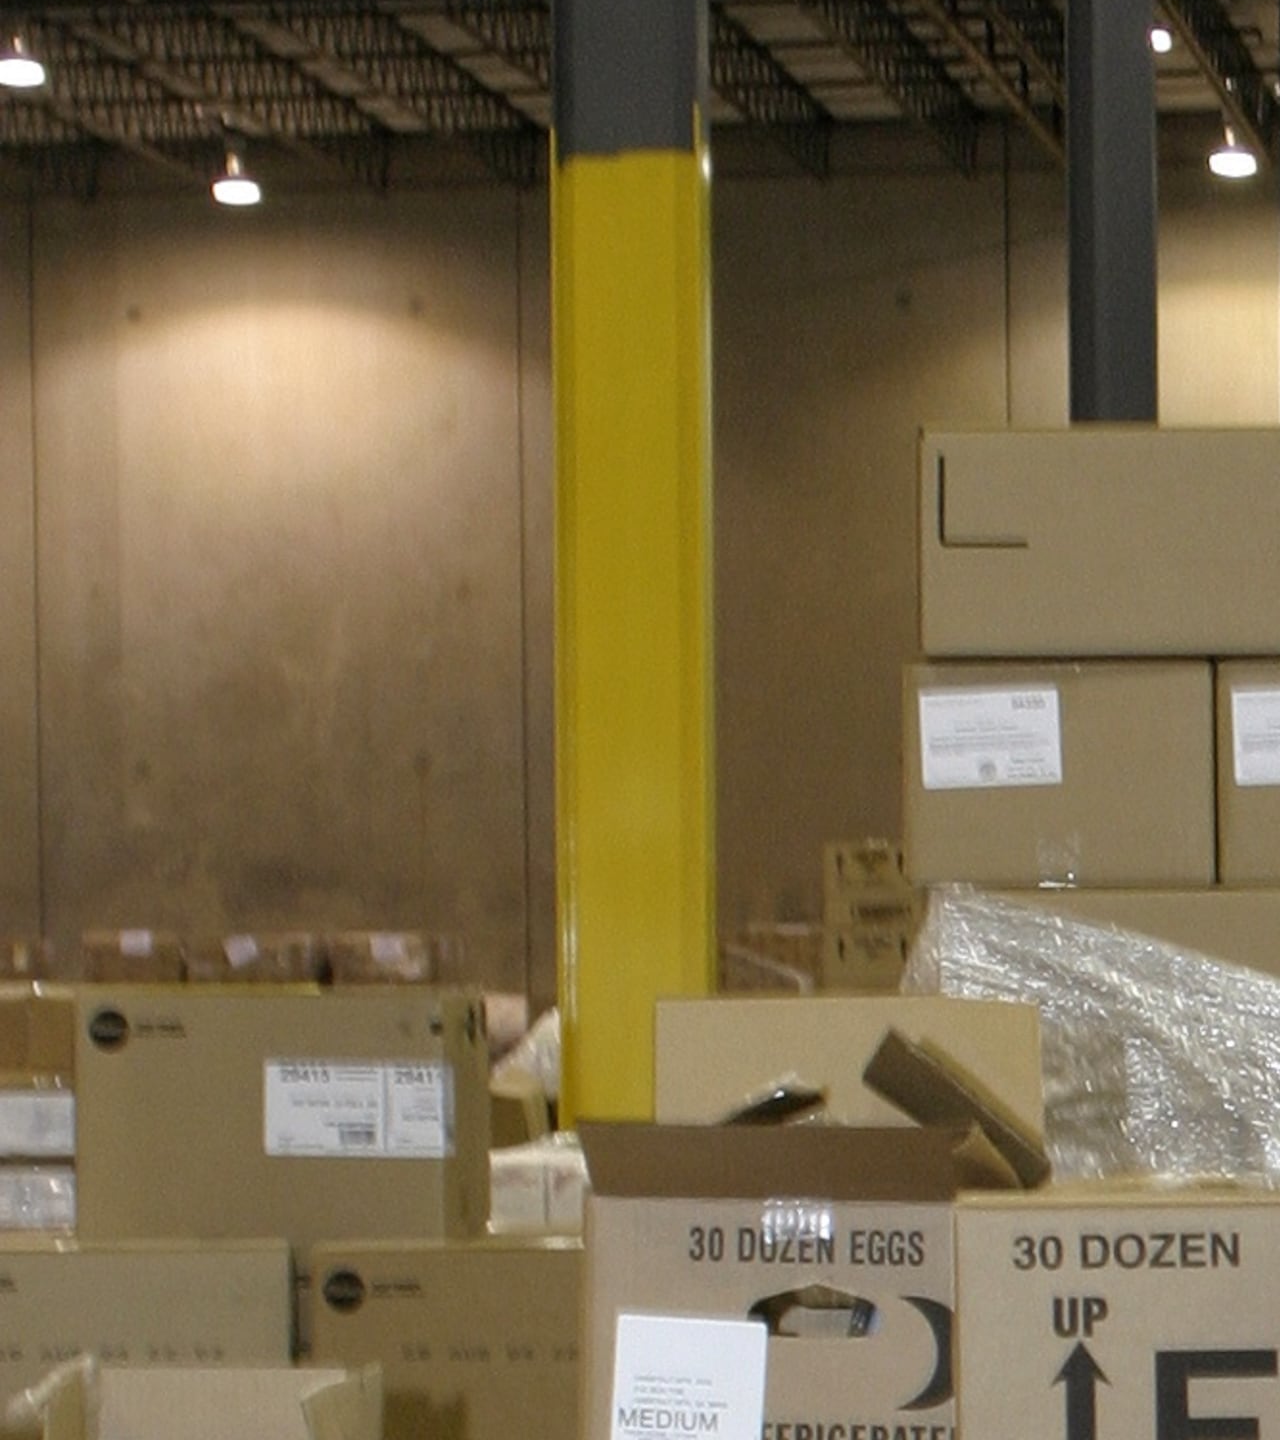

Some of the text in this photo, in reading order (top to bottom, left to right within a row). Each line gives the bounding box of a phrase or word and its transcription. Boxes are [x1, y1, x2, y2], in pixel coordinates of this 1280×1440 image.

[689, 1226, 926, 1266] 30 DOZEN EGGS
[1012, 1232, 1241, 1272] 30 DOZEN
[1053, 1297, 1108, 1339] UP
[618, 1408, 719, 1433] MEDIUM
